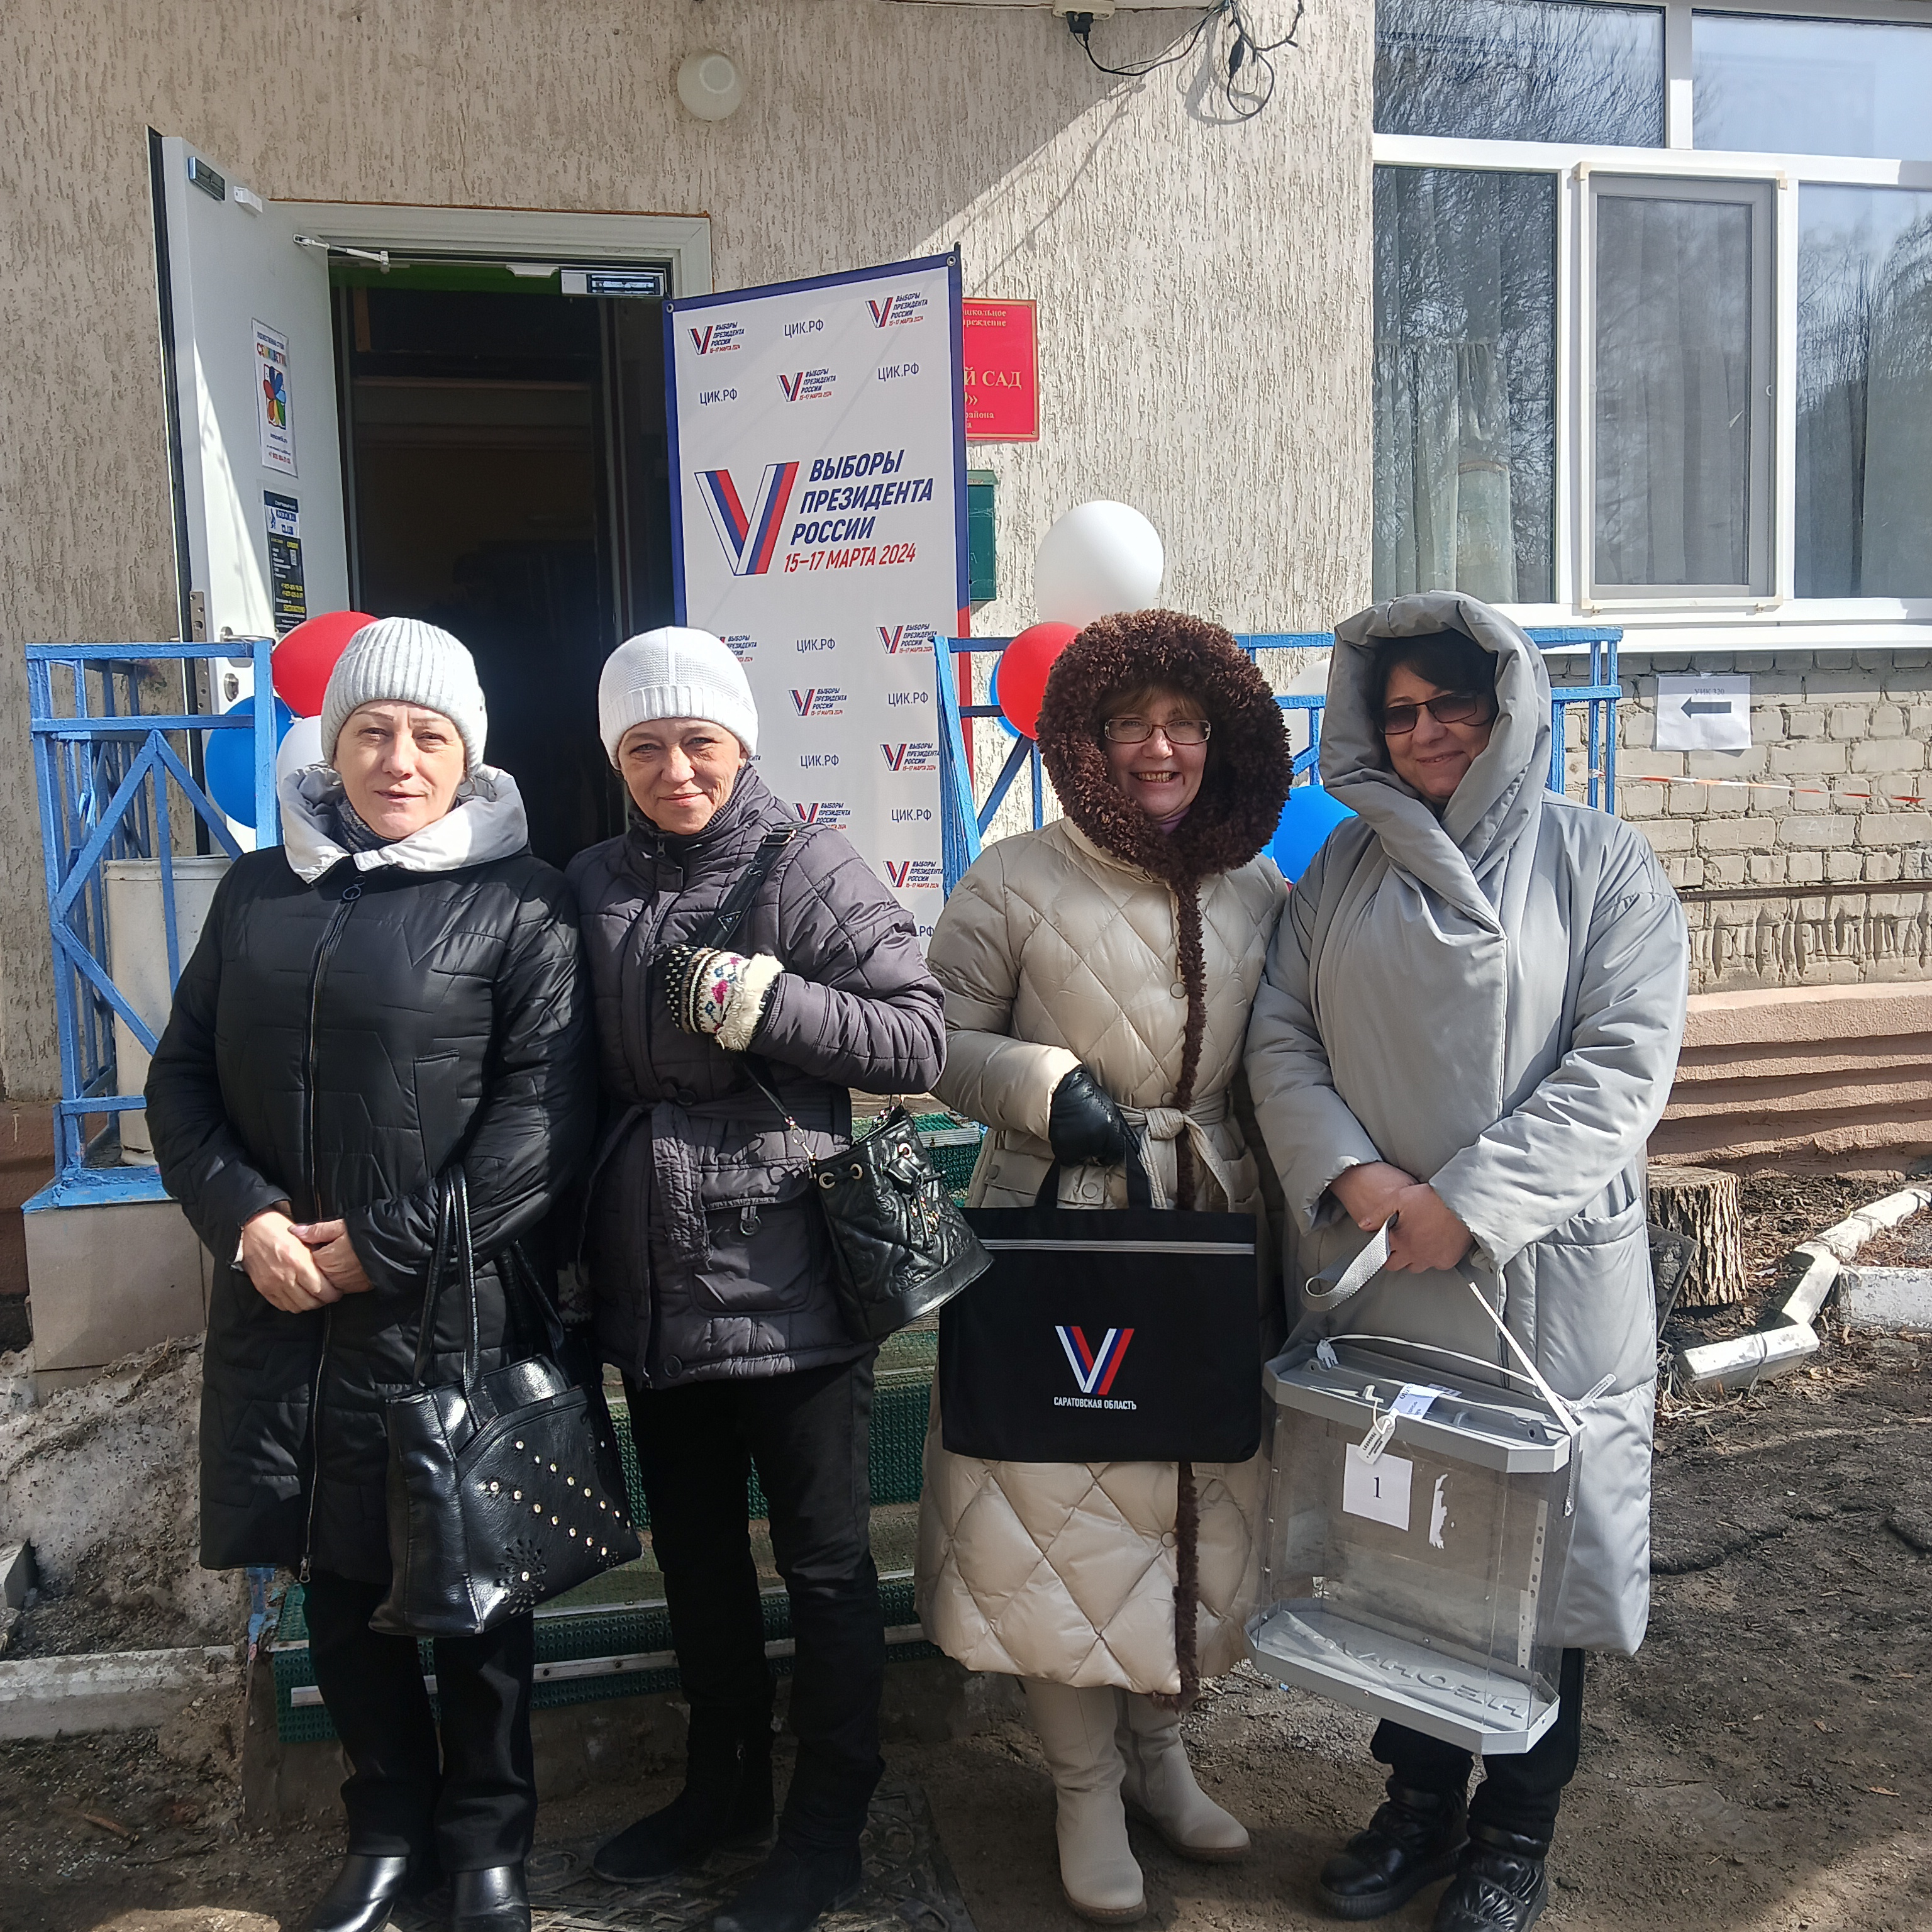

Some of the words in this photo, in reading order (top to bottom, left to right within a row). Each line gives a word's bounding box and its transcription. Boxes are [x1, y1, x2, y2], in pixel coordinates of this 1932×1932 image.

[784, 318, 824, 338] ЦИК.РФ
[878, 363, 919, 382] ЦИК.РФ
[982, 370, 1021, 389] САД
[700, 389, 738, 406] ЦИК.РФ
[809, 449, 904, 482] ВЫБОРЫ
[800, 478, 933, 514] ПРЕЗИДЕНТА
[791, 516, 875, 545] РОССИИ
[826, 547, 875, 570] МАРТА
[879, 543, 916, 565] 2024
[797, 638, 835, 653] ЦИК.РФ
[888, 691, 928, 707] ЦИК.РФ
[801, 754, 839, 767] ЦИК.РФ
[891, 809, 931, 822] ЦИК.РФ
[1053, 1396, 1102, 1408] САРАТОВСКАЯ
[1104, 1400, 1136, 1409] ОБЛАСТЬ
[1373, 1477, 1382, 1499] 1
